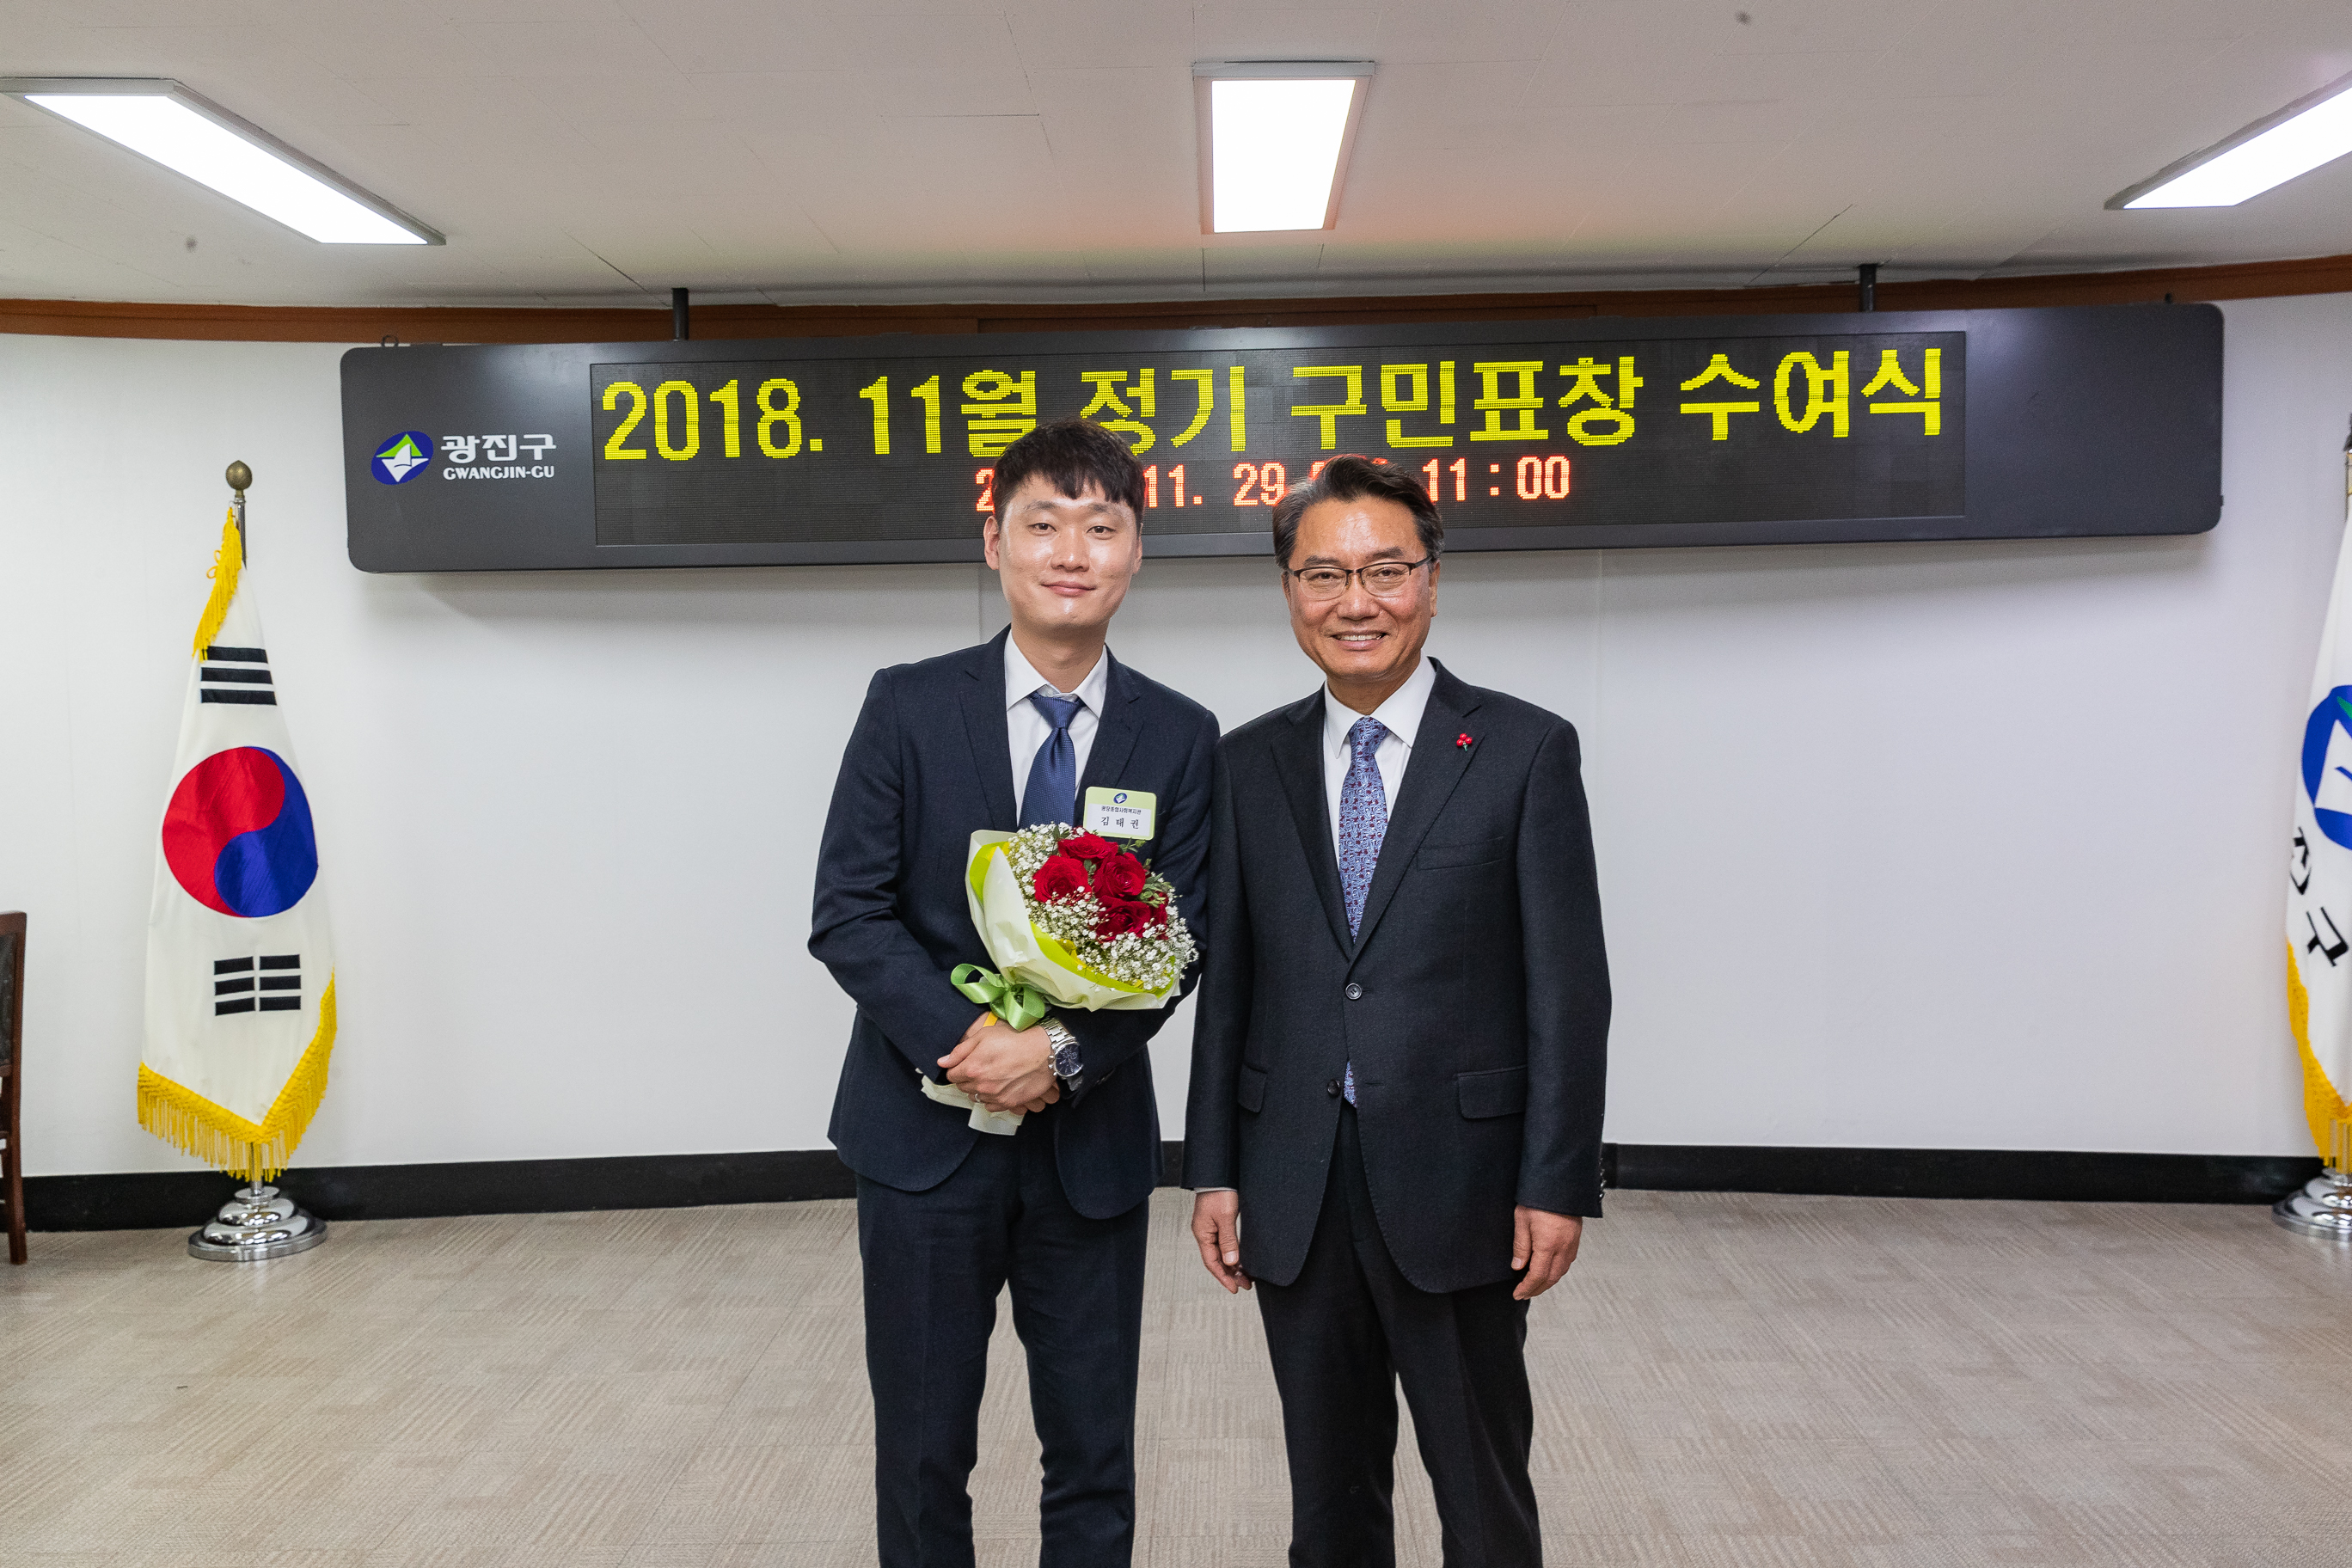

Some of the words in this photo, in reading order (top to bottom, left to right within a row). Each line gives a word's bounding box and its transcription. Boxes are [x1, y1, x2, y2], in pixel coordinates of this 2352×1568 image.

[603, 378, 824, 462] 2018.
[859, 370, 1037, 457] 11월
[1080, 365, 1246, 456] 정기
[1290, 356, 1644, 450] 구민표창
[1680, 347, 1942, 441] 수여식
[440, 433, 557, 464] 광진구
[443, 465, 555, 481] GWANGJIN-GU
[1142, 464, 1204, 509] 11.
[1233, 461, 1287, 507] 29
